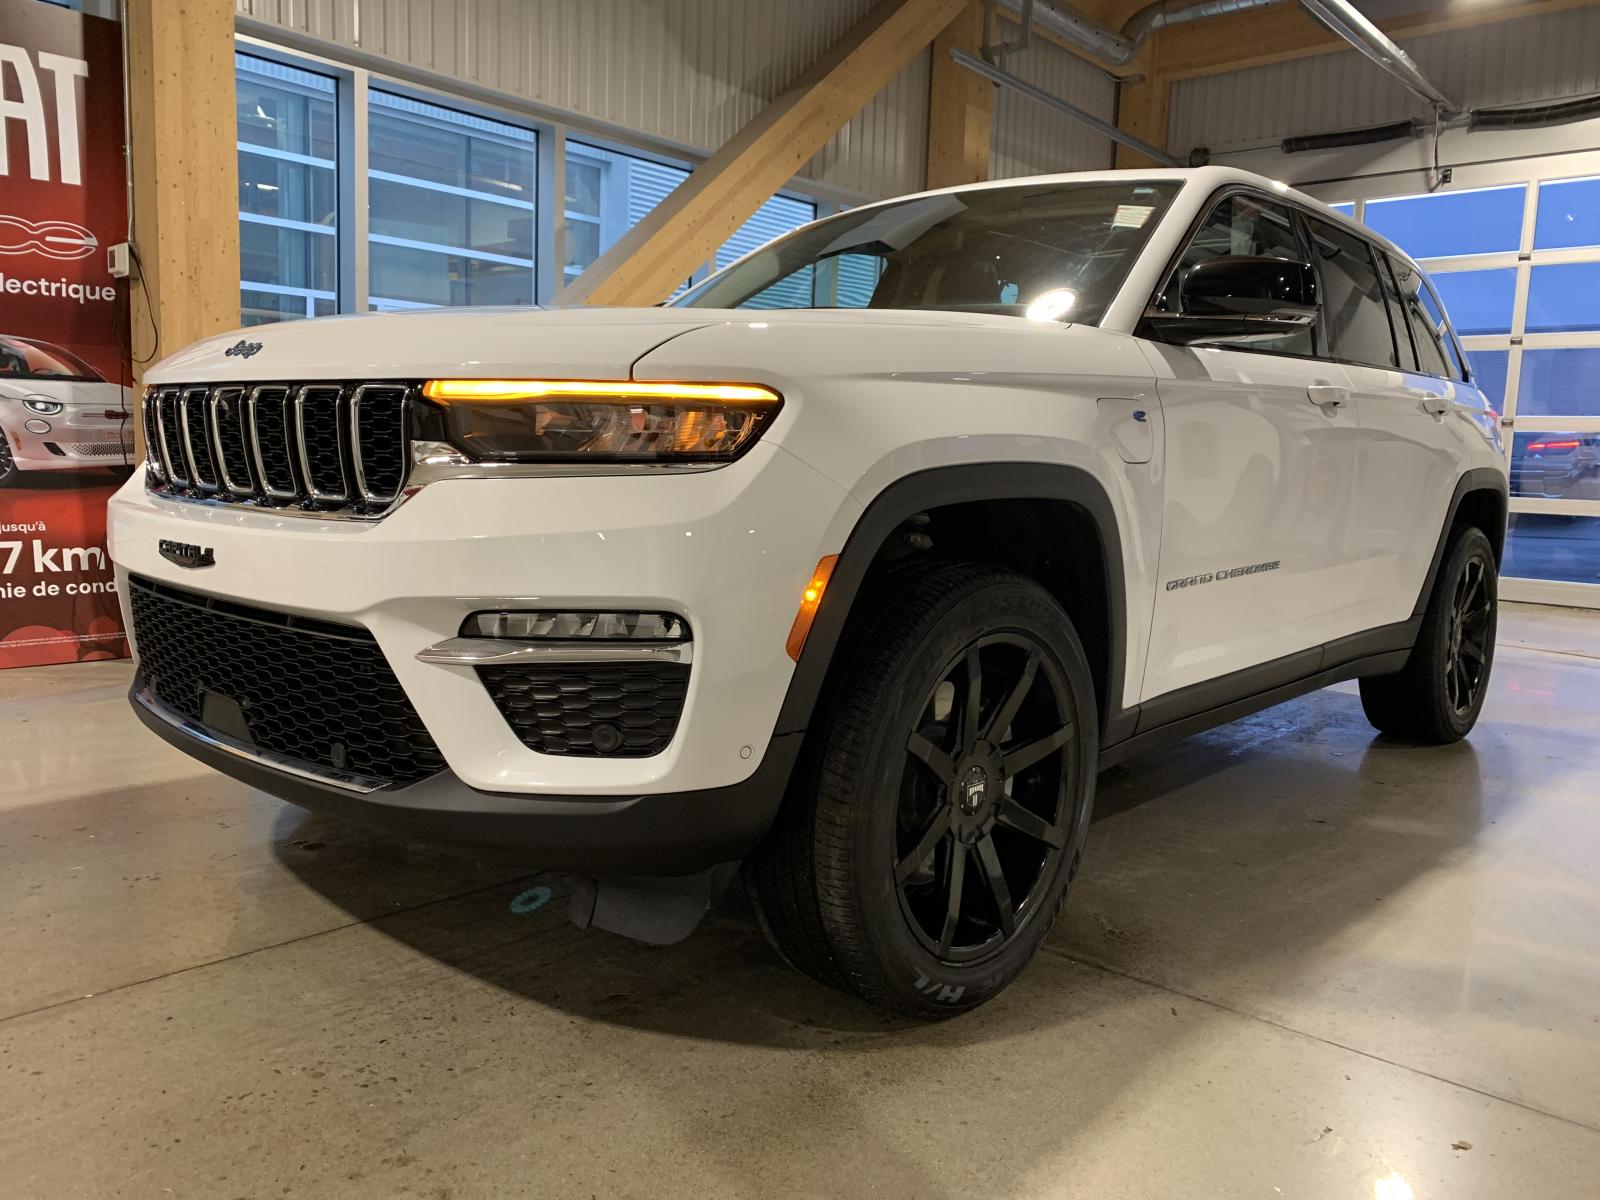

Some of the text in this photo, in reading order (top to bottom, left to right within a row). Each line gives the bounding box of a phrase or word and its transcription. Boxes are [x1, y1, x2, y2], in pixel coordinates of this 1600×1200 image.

[33, 540, 106, 573] km
[33, 581, 60, 597] de
[1166, 561, 1280, 591] GRAND CHEROKEE
